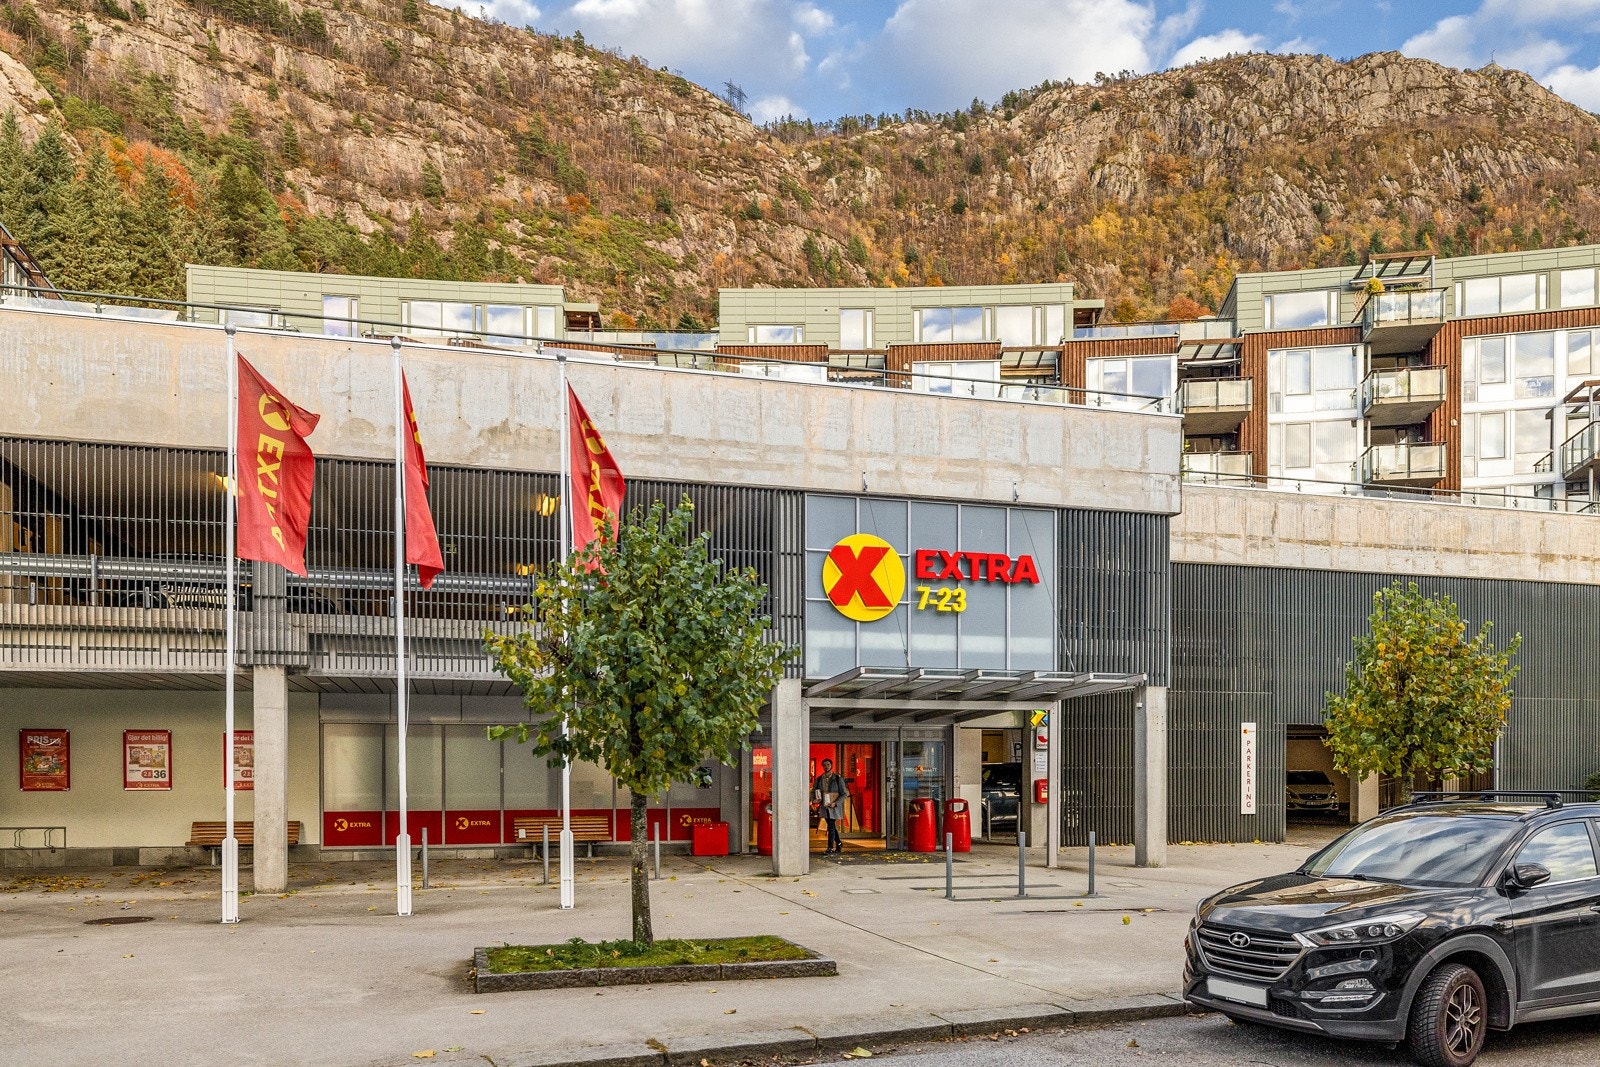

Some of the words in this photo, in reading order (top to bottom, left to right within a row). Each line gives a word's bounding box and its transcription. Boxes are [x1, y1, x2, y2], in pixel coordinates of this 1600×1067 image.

[916, 549, 1040, 585] EXTRA
[916, 587, 967, 612] 7-23
[27, 735, 49, 744] PRIS
[153, 769, 167, 779] 36
